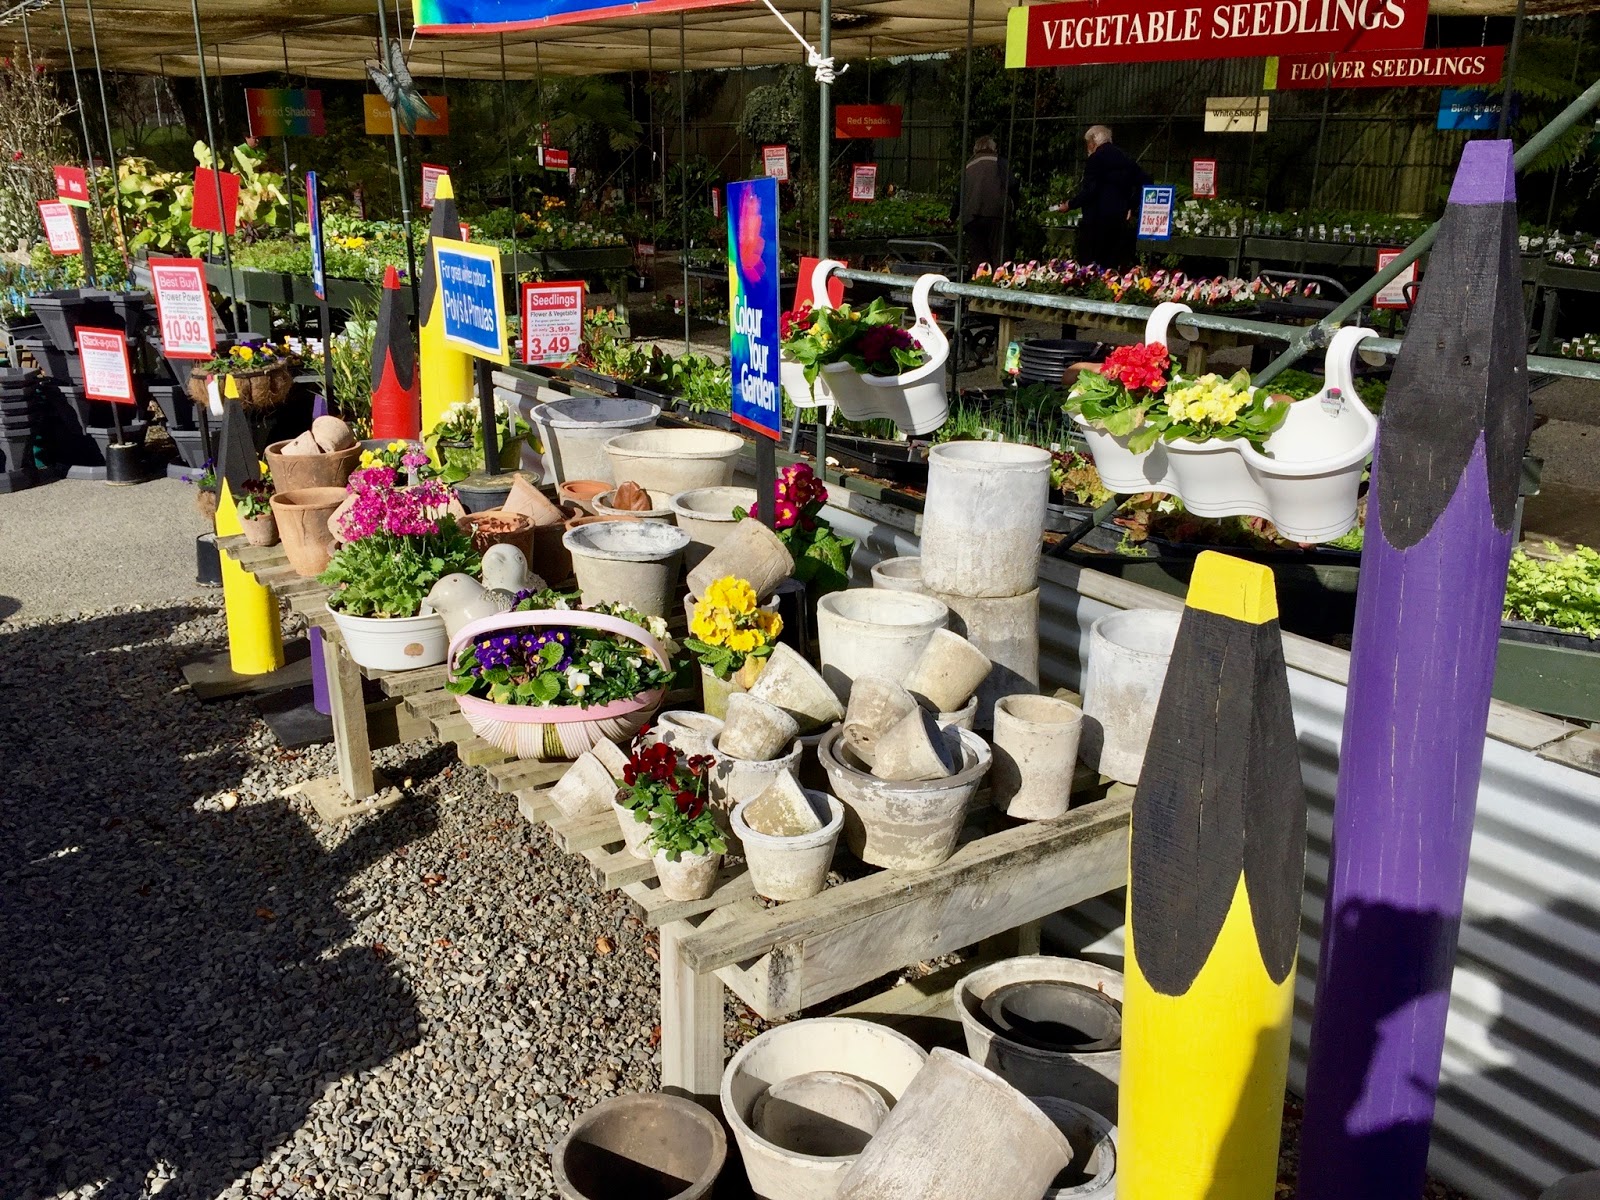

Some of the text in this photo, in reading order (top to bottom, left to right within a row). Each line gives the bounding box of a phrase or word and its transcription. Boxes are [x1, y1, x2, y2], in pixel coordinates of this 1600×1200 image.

[1042, 0, 1406, 50] VEGETABLE SEEDLINGS
[1290, 55, 1487, 81] FLOWER SEEDLINGS
[284, 105, 317, 118] Shades
[1212, 109, 1234, 117] White
[1450, 103, 1502, 113] Blue Shade
[846, 116, 891, 125] Red Shades
[440, 259, 451, 279] For
[451, 265, 462, 285] great
[160, 275, 199, 289] Best Buy!
[160, 290, 202, 302] Flower Power
[532, 293, 576, 308] Seedlings
[553, 309, 578, 318] Vegetable
[733, 294, 763, 339] Colour
[165, 319, 201, 342] 10.99
[549, 325, 571, 333] 3.99
[531, 336, 570, 355] 3.49
[747, 332, 769, 374] Your
[740, 362, 776, 413] Garden
